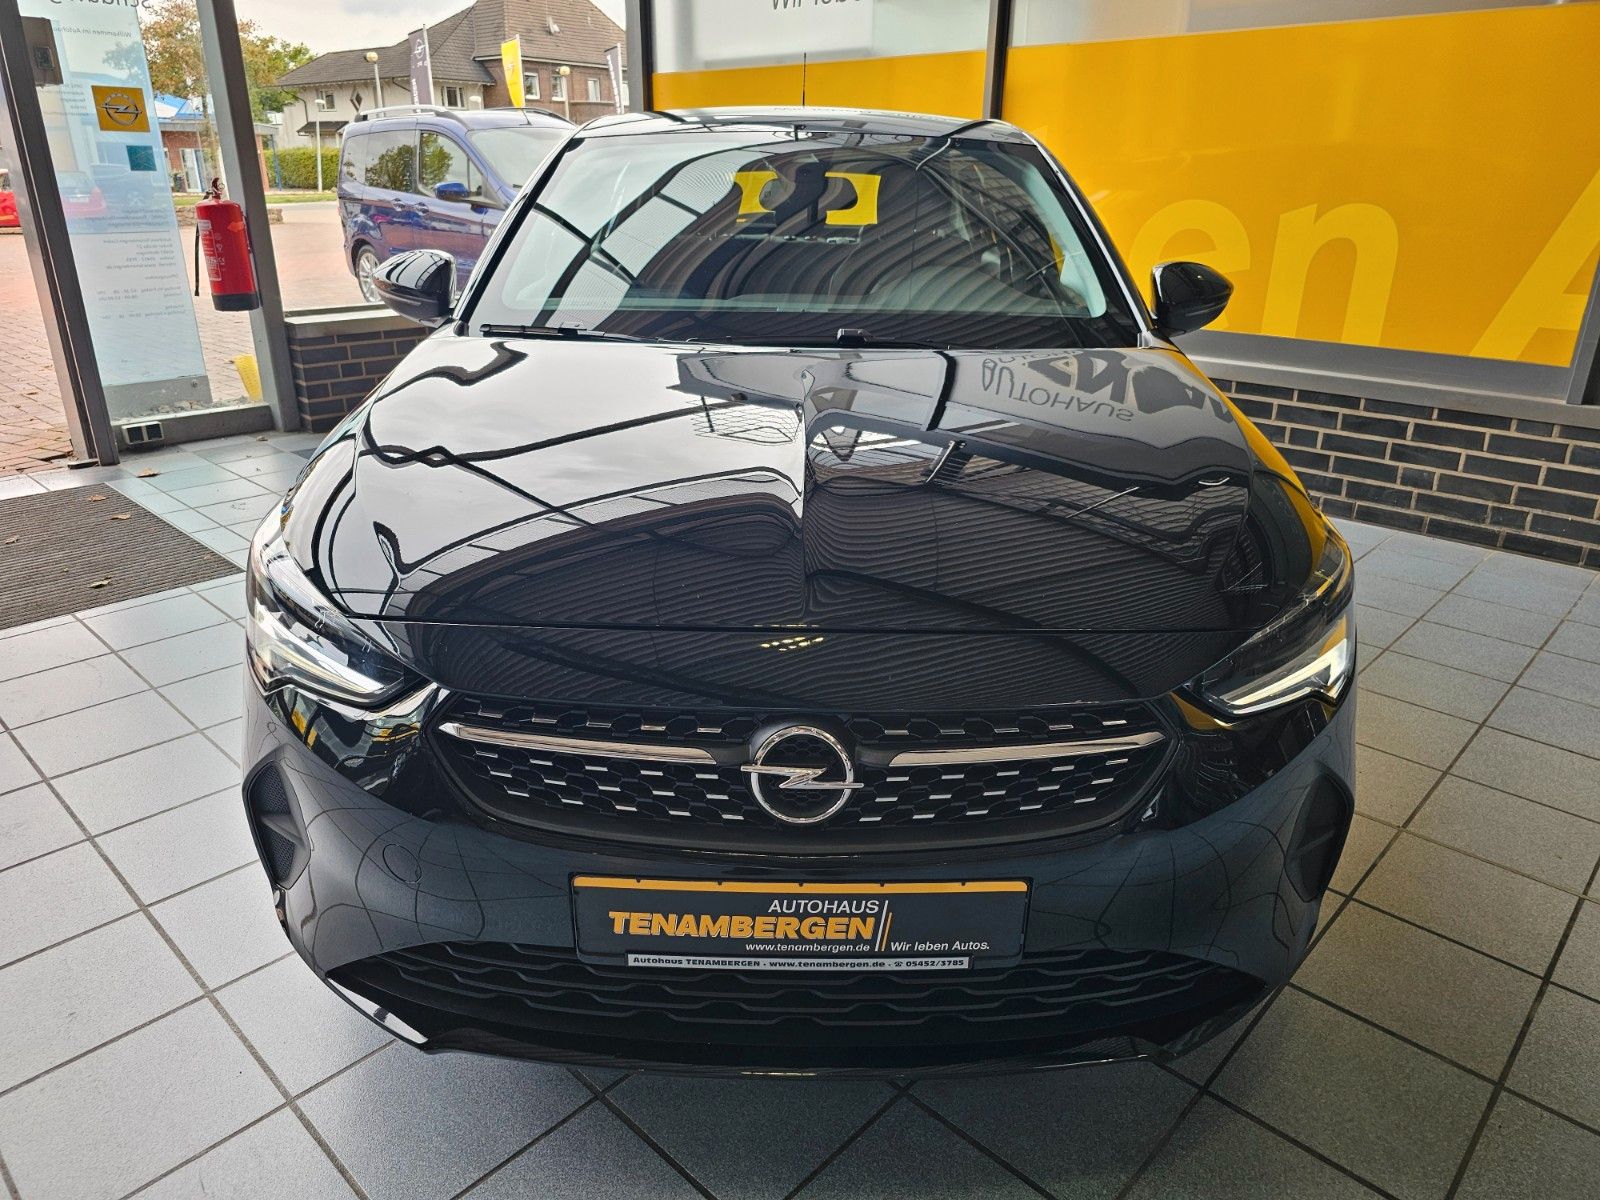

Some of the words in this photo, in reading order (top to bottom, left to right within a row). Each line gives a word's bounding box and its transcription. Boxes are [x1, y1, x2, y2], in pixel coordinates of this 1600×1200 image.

[768, 900, 880, 914] AUTOHAUS
[608, 911, 876, 940] TENAMBERGEN
[745, 942, 871, 954] www.tenambergen.de
[890, 941, 912, 951] Wir
[914, 941, 949, 951] leben
[951, 940, 990, 951] Autos.
[633, 956, 683, 966] Autohaus
[686, 958, 760, 968] TENAMBERGEN
[769, 960, 886, 970] www.tenambergen.de
[905, 959, 964, 968] 05452/3785
